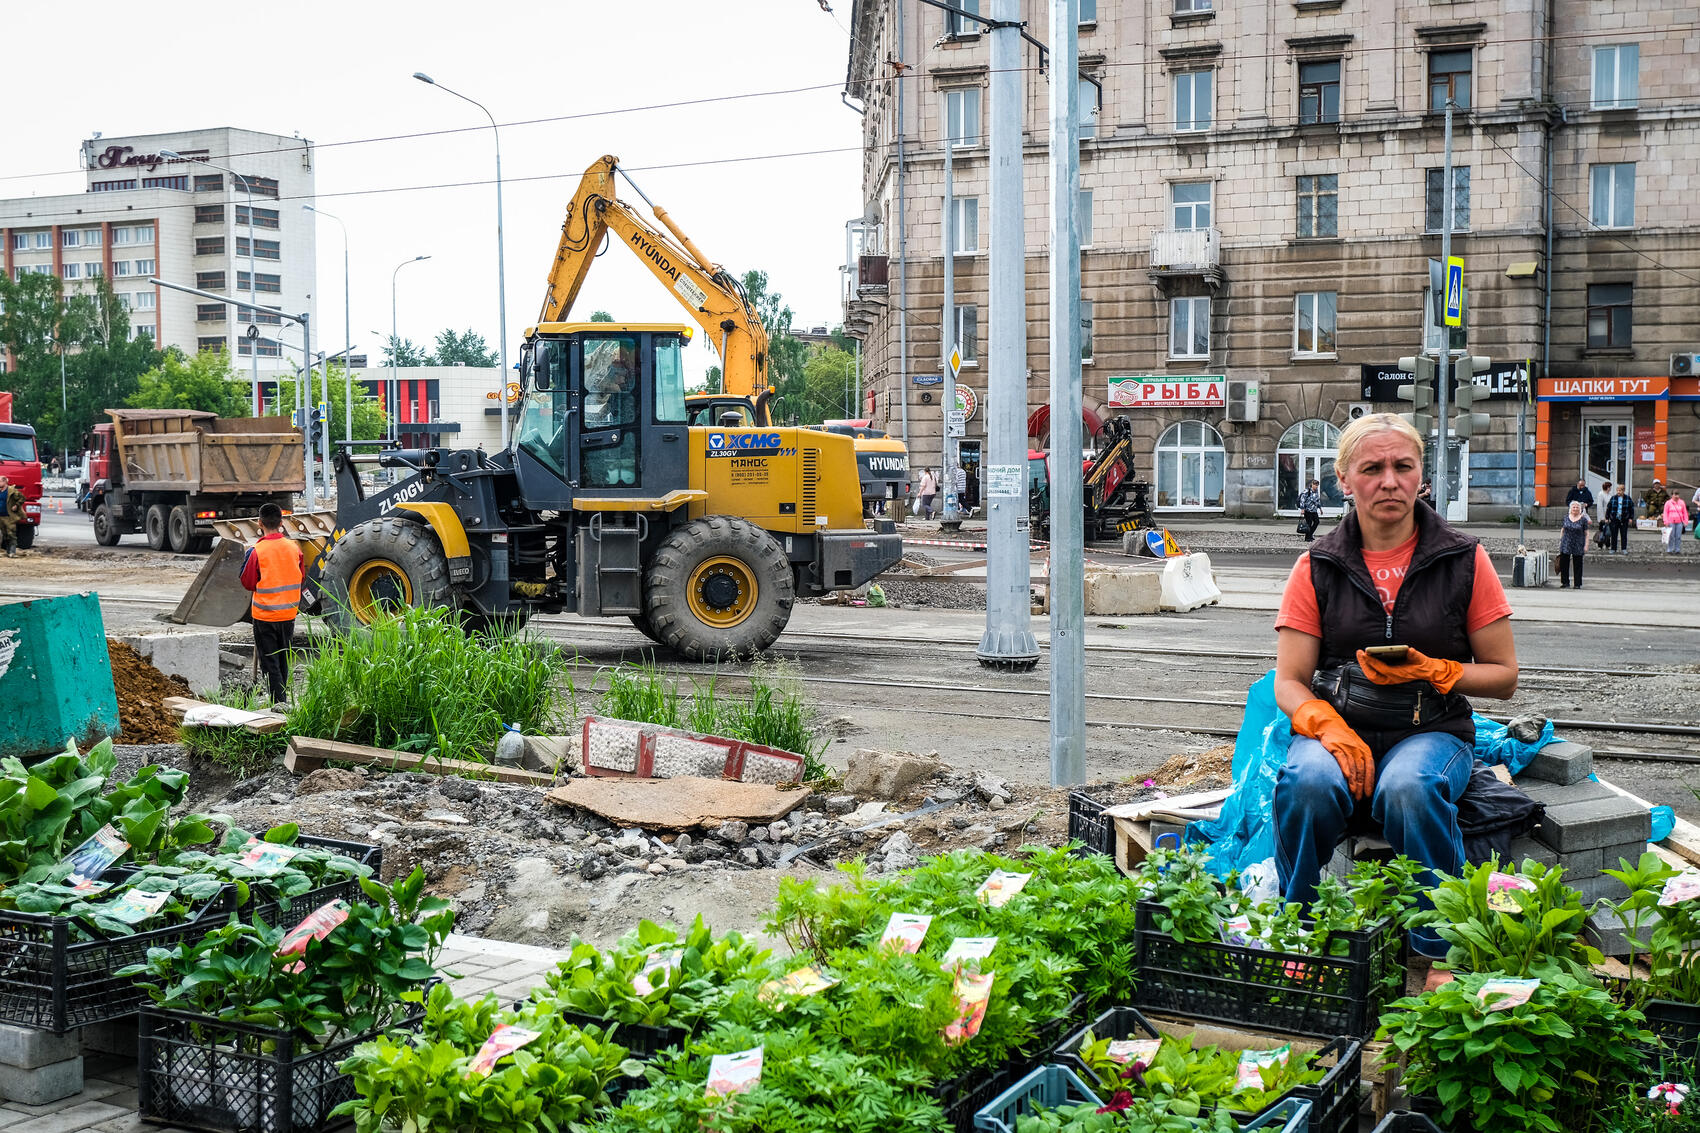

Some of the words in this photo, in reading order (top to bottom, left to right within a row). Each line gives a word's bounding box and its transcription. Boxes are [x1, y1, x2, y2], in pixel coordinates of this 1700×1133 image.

[631, 232, 681, 282] HYUNDAI
[1377, 371, 1406, 381] Салон
[1142, 383, 1220, 400] РЫБА
[1554, 380, 1615, 393] ШАПКИ
[1619, 379, 1651, 393] ТУТ
[726, 433, 782, 449] XCMG
[869, 457, 906, 471] HYUNDA
[379, 479, 425, 516] ZL30GV
